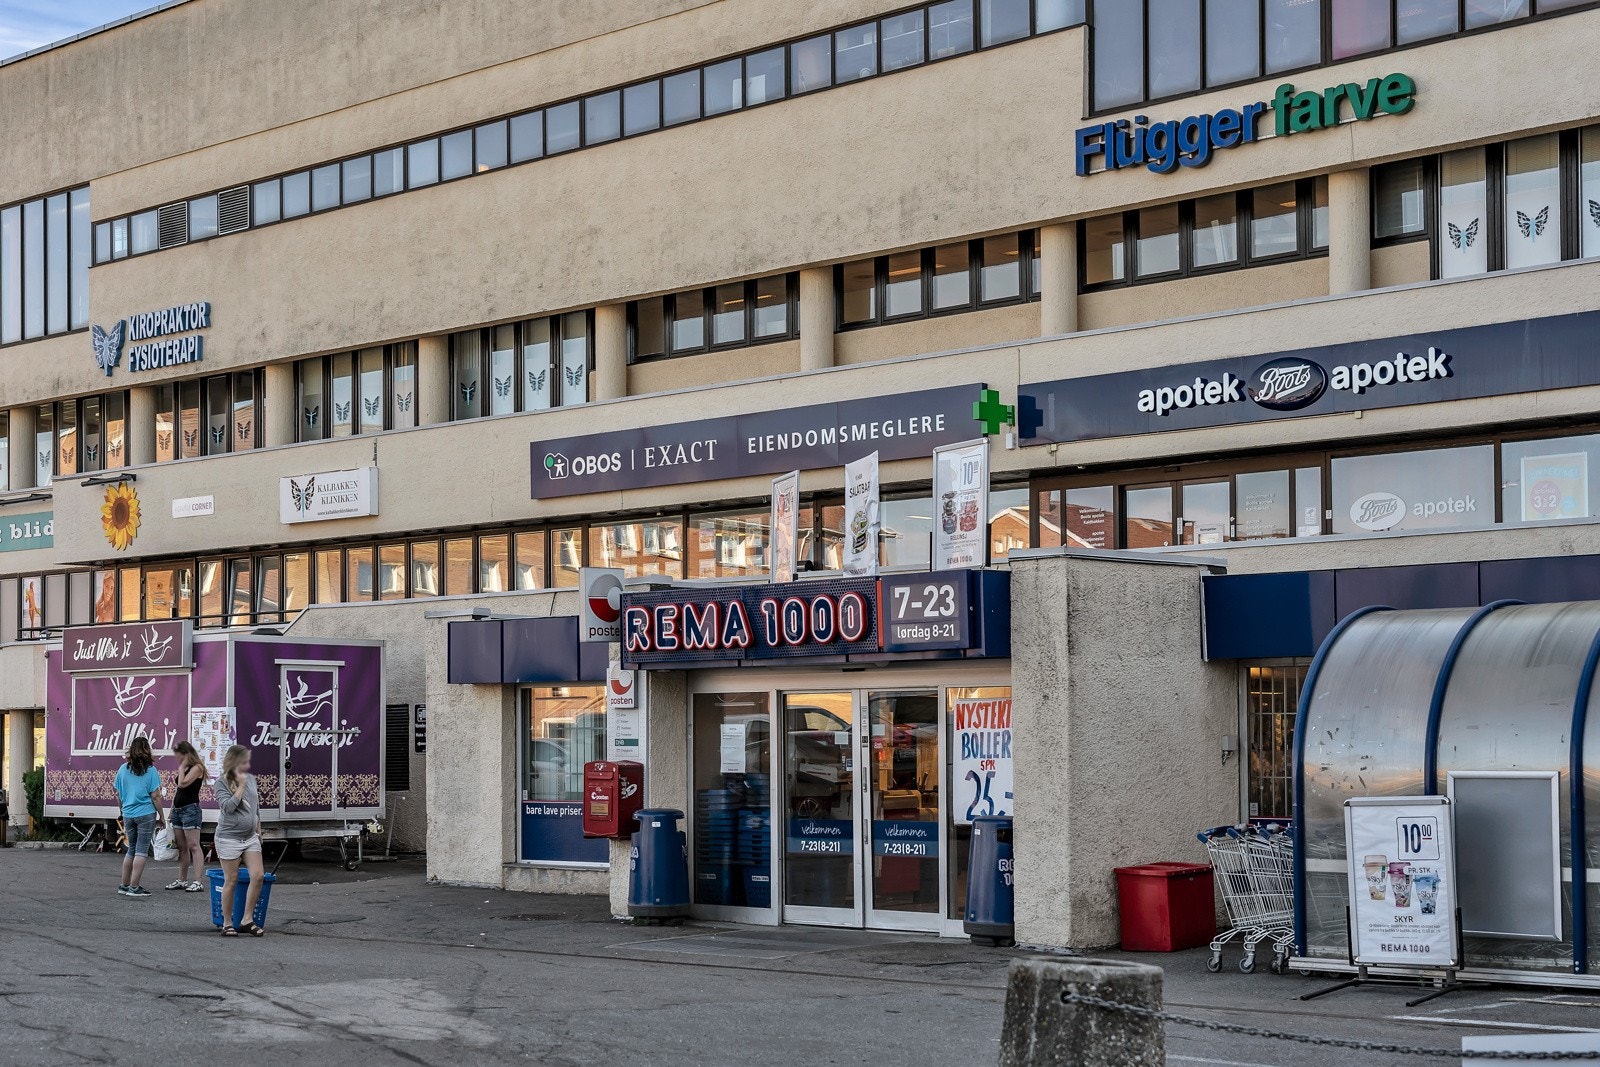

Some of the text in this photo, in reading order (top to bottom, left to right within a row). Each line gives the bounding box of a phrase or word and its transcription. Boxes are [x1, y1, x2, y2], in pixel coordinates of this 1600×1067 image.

[1075, 72, 1416, 177] Flügger farve
[128, 302, 210, 341] KIROPRAKTOR
[128, 335, 203, 372] FYSIOTERAPI
[1137, 346, 1448, 416] apotek Boots apotek
[572, 414, 945, 476] OBOS EXACT EIENDOMSMEGLERE
[317, 480, 359, 493] KALBAKKEN
[191, 501, 213, 511] CORNER
[321, 493, 359, 505] KLINIKKEN
[1534, 495, 1541, 508] 3
[1548, 494, 1557, 508] 2
[1356, 495, 1477, 523] Boots apotek
[9, 520, 54, 540] blid
[894, 584, 955, 619] 7-23
[624, 591, 868, 652] REMA 1000
[897, 623, 954, 641] lørdag 8-21
[73, 633, 132, 661] Just Wok it
[610, 696, 633, 705] posten
[87, 723, 122, 750] Just
[961, 730, 1012, 760] BOLLER
[526, 804, 542, 815] bare
[543, 805, 559, 815] lave
[560, 805, 583, 818] priser.
[801, 822, 841, 836] velkommen
[885, 824, 928, 837] velkommen
[1402, 823, 1421, 854] 10
[801, 840, 841, 853] 7-23(8-21)
[884, 842, 926, 855] 7-23(8-21)
[1394, 915, 1413, 923] SKYR
[1381, 944, 1430, 953] REMA 1000
